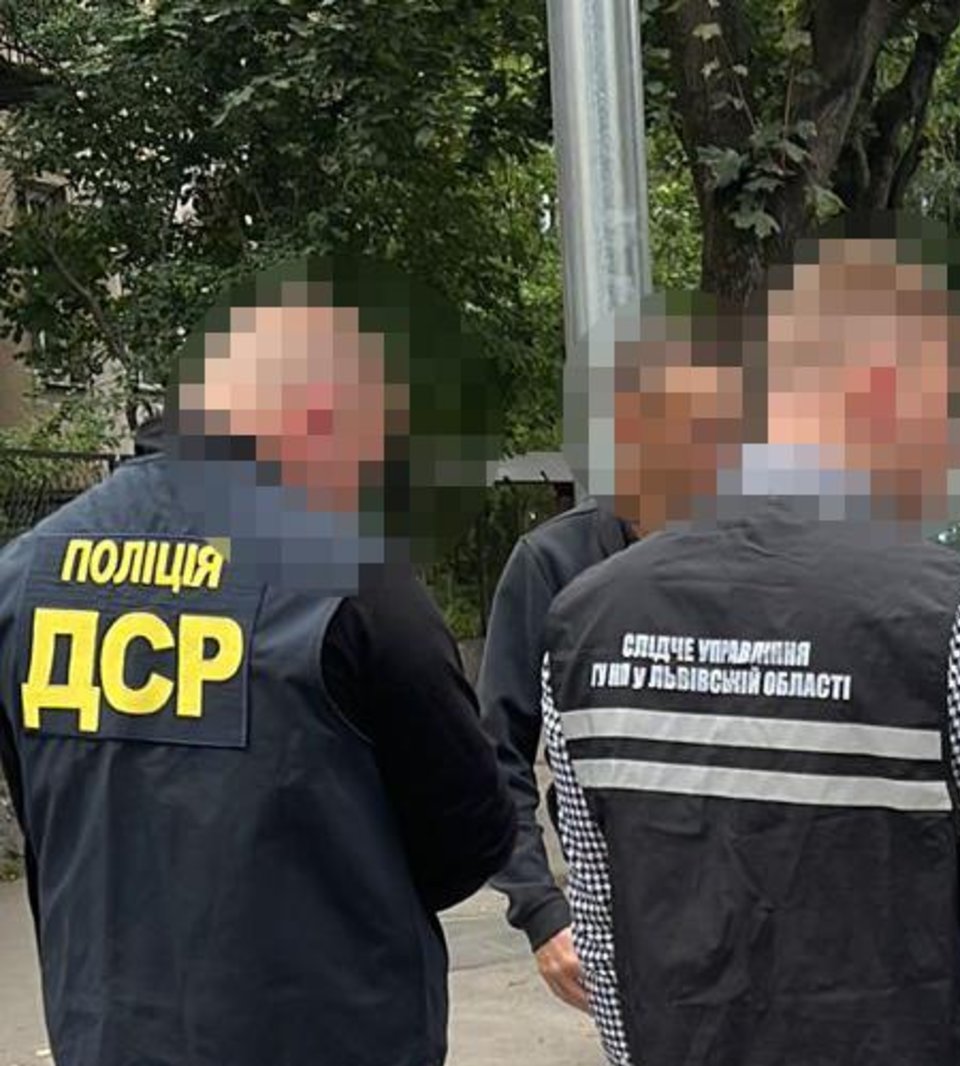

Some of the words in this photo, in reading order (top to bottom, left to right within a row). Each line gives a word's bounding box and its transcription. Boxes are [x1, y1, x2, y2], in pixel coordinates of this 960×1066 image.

[60, 538, 223, 593] ПОЛІЦІЯ
[21, 607, 243, 732] ДСР
[622, 633, 695, 662] СЛІДЧЕ
[648, 664, 760, 695] ЛЬВІВСЬКІЙ
[763, 671, 851, 700] ОБЛАСТІ
